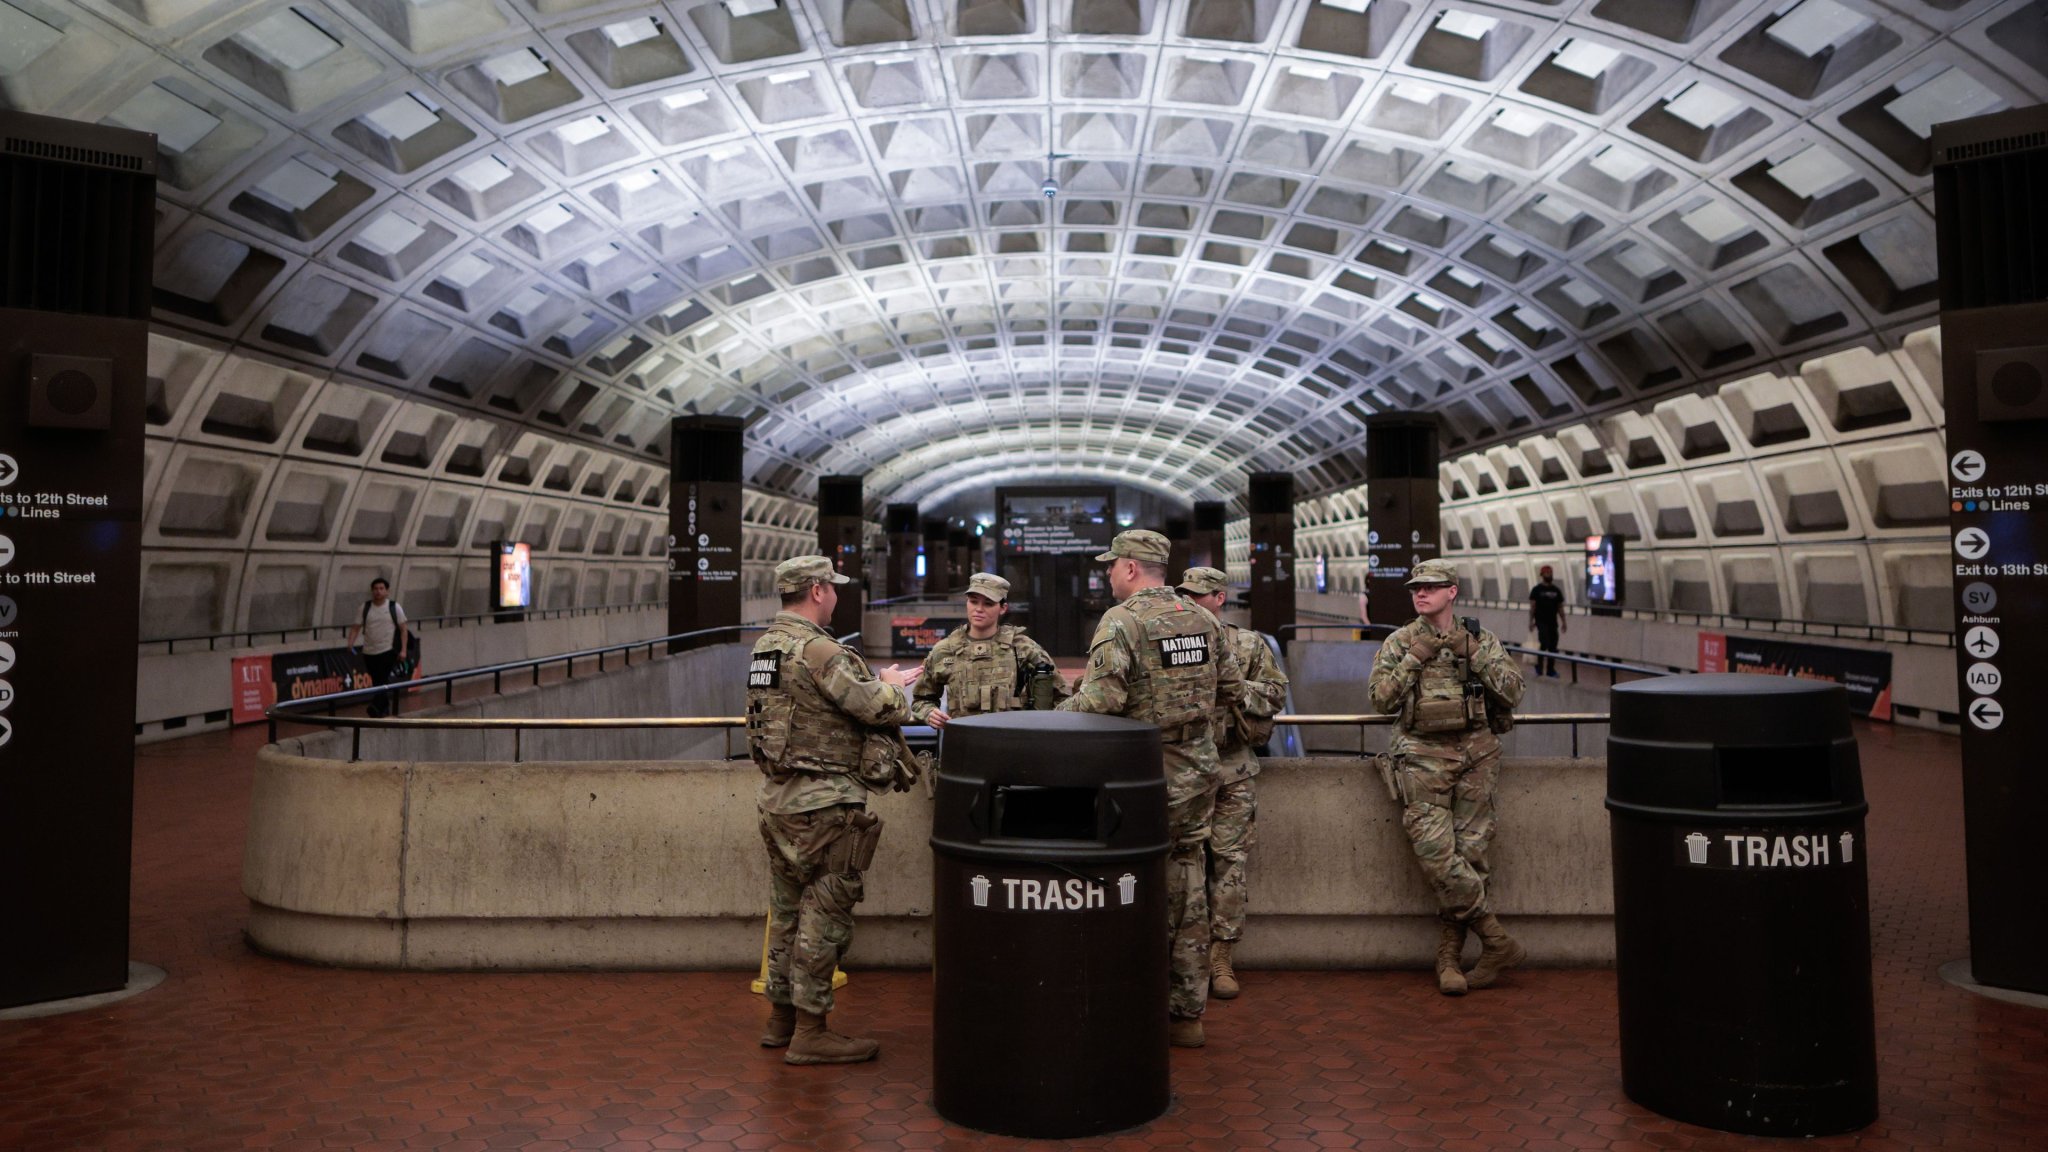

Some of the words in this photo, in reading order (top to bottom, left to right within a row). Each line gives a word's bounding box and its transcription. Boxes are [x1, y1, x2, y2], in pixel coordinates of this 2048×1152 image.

[1952, 487, 1984, 498] Exits
[1986, 486, 2001, 497] to
[2003, 485, 2032, 497] 12th
[17, 492, 31, 504] to
[34, 493, 63, 505] 12th
[66, 493, 108, 506] Street
[1991, 499, 2030, 511] Lines
[21, 506, 60, 518] Lines
[1956, 564, 1982, 576] Exit
[1984, 564, 1998, 575] to
[2001, 563, 2030, 575] 13th
[6, 572, 20, 584] to
[24, 572, 50, 583] 11th
[53, 571, 96, 583] Street
[1968, 591, 1990, 604] SV
[1962, 615, 2000, 624] Ashburn
[1161, 635, 1207, 652] NATIONAL
[1171, 649, 1203, 665] GUARD
[1970, 672, 1999, 685] IAD
[1724, 834, 1829, 867] TRASH
[1002, 877, 1105, 911] TRASH
